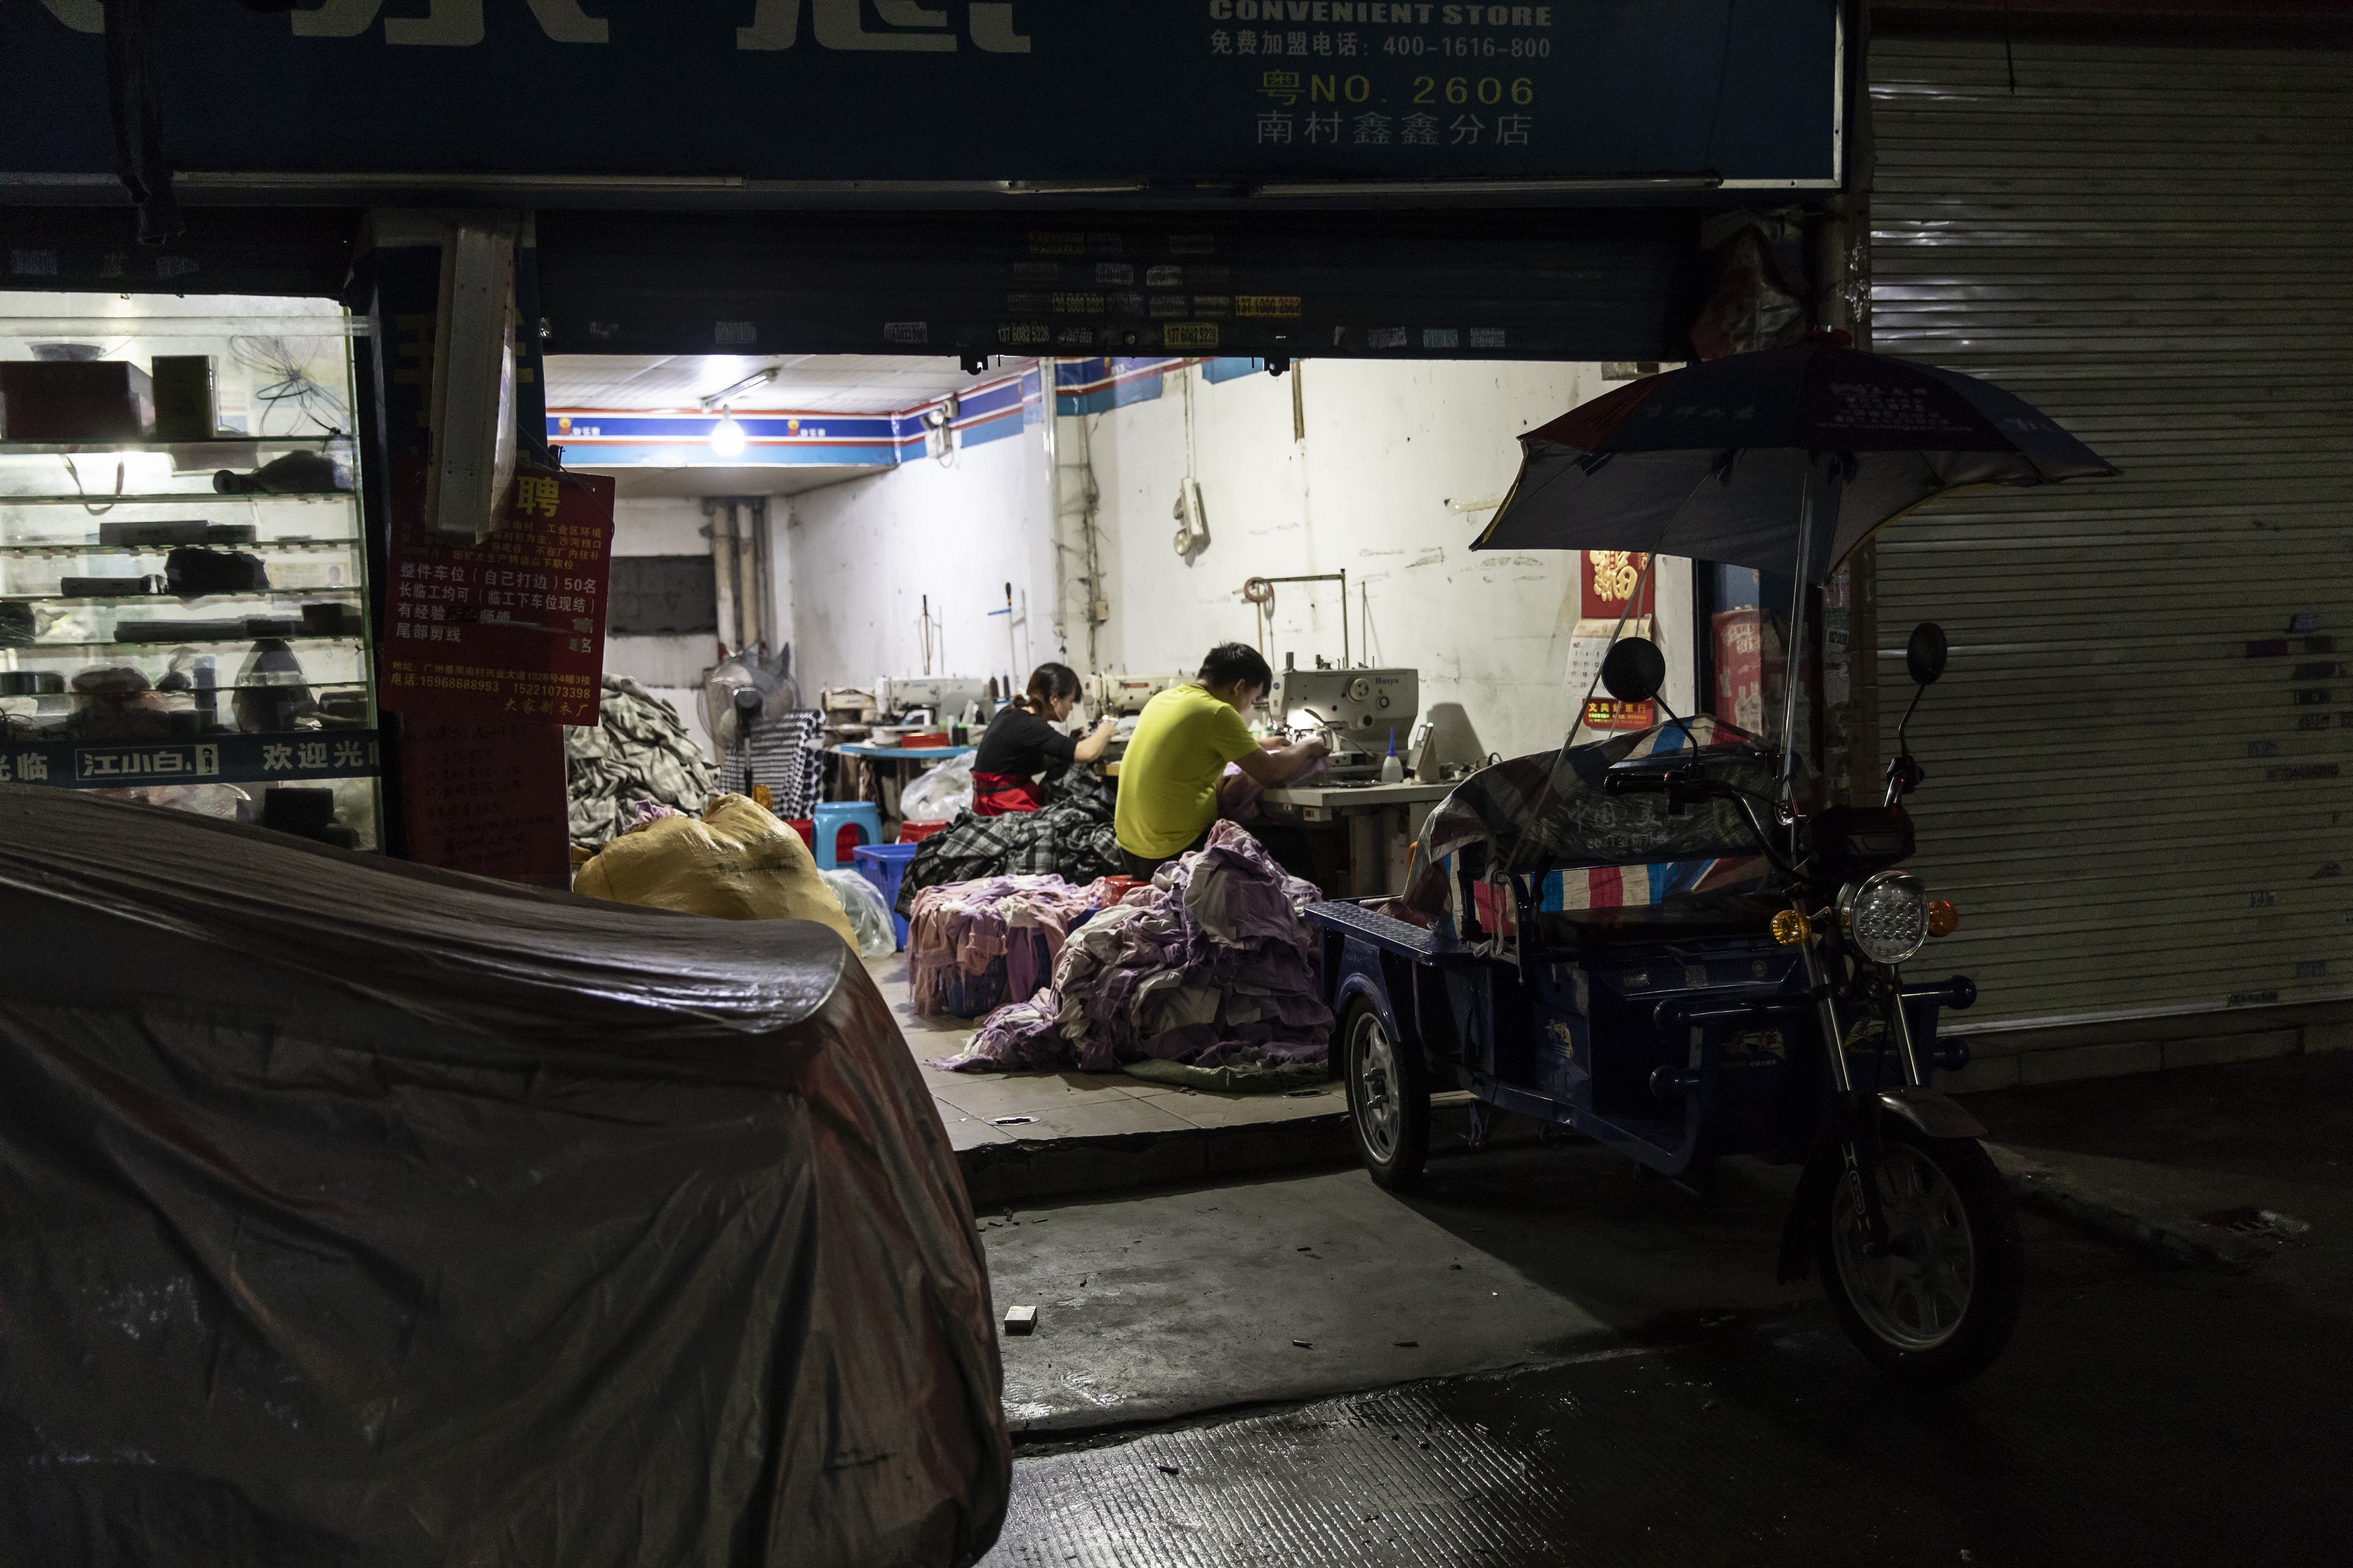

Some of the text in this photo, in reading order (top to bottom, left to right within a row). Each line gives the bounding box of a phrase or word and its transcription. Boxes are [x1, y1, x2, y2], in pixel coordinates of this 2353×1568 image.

[1209, 0, 1552, 27] CONVENIENT STORE
[1257, 110, 1533, 145] 南村鑫鑫分店
[517, 475, 560, 517] 聘
[398, 602, 511, 624] 有经验师傅
[396, 622, 462, 643] 尾部剪线
[83, 750, 183, 775] 江小白
